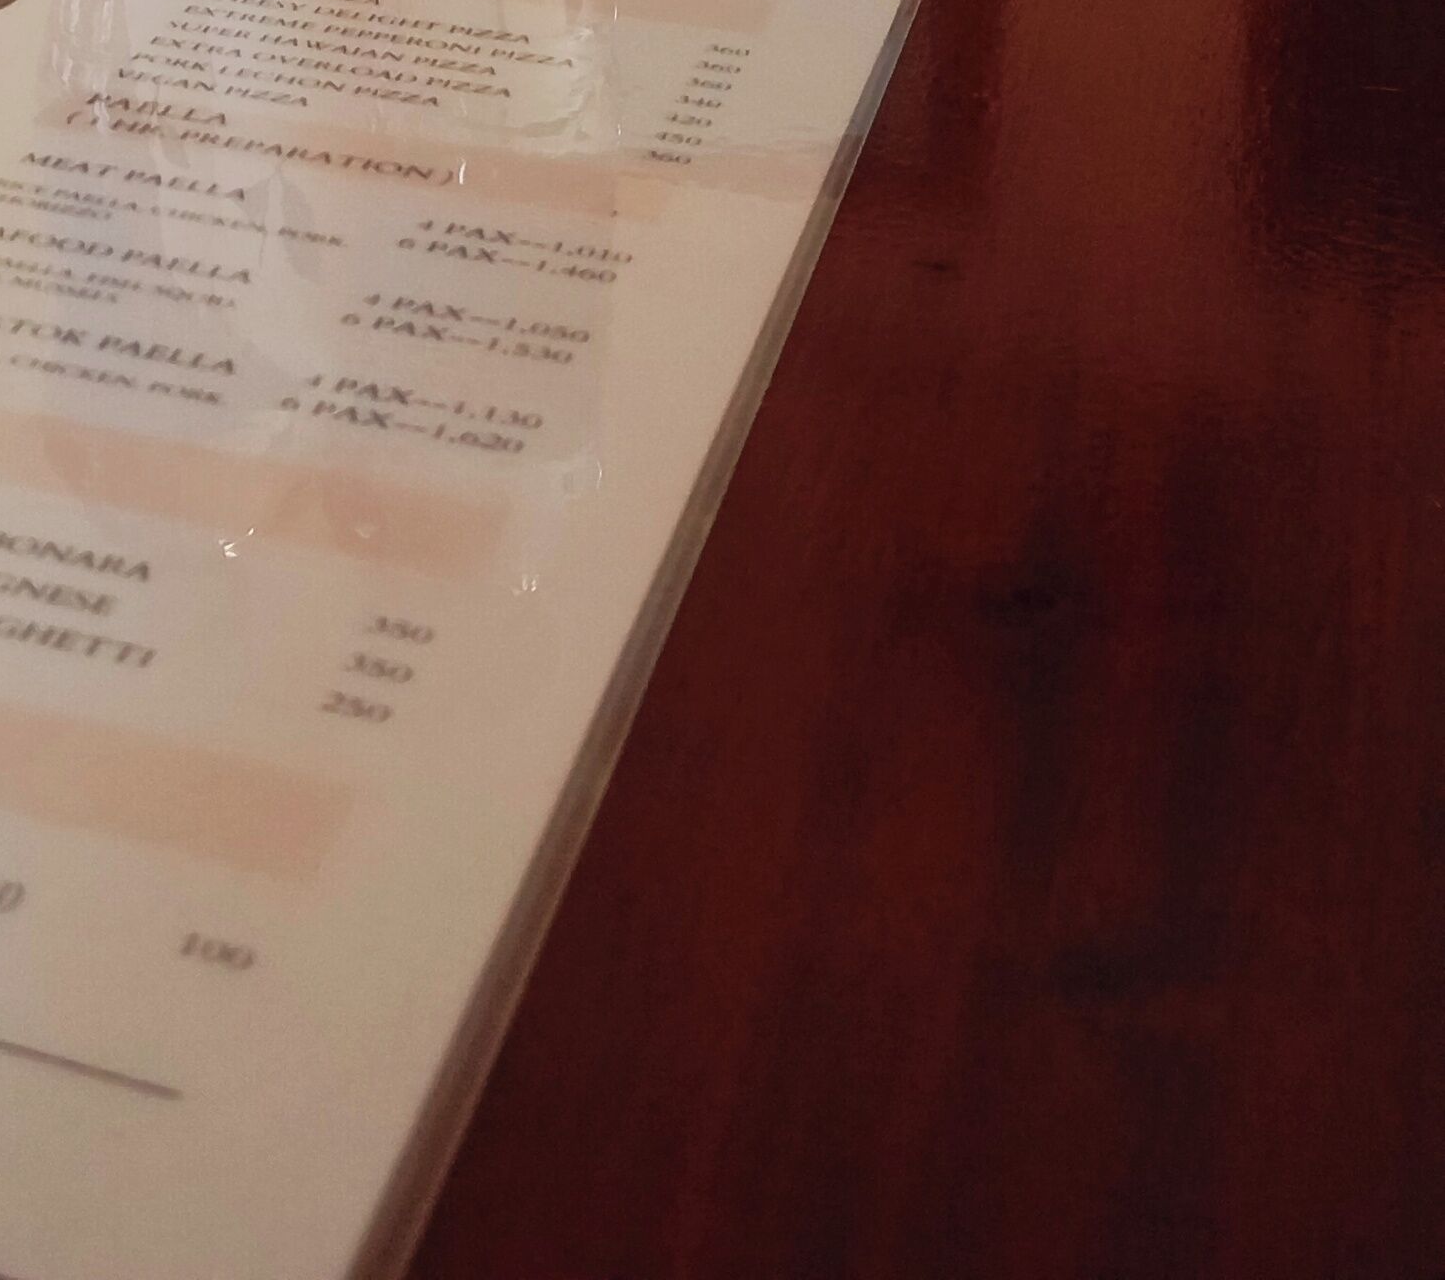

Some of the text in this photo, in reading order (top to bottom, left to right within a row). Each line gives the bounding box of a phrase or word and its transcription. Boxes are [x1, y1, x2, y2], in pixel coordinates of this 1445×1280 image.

[167, 20, 251, 39] SUPER
[411, 55, 498, 76] PIZZA
[183, 5, 315, 31] EXTREME
[322, 25, 482, 55] PEPPERONI
[488, 48, 575, 68] PIZZA
[312, 6, 439, 31] DELIGHT
[447, 25, 532, 44] PIZZA
[115, 67, 217, 92] VEGAN
[224, 85, 311, 107] PIZZA
[130, 53, 208, 72] PORK
[352, 85, 442, 107] PIZZA
[149, 36, 243, 58] EXTRA
[250, 52, 419, 83] OVERLOAD
[424, 76, 513, 98] PIZZA
[22, 152, 114, 177] MEAT
[121, 169, 250, 202] PAELLA
[118, 248, 255, 284] PAELLA
[95, 335, 240, 376] PAELLA
